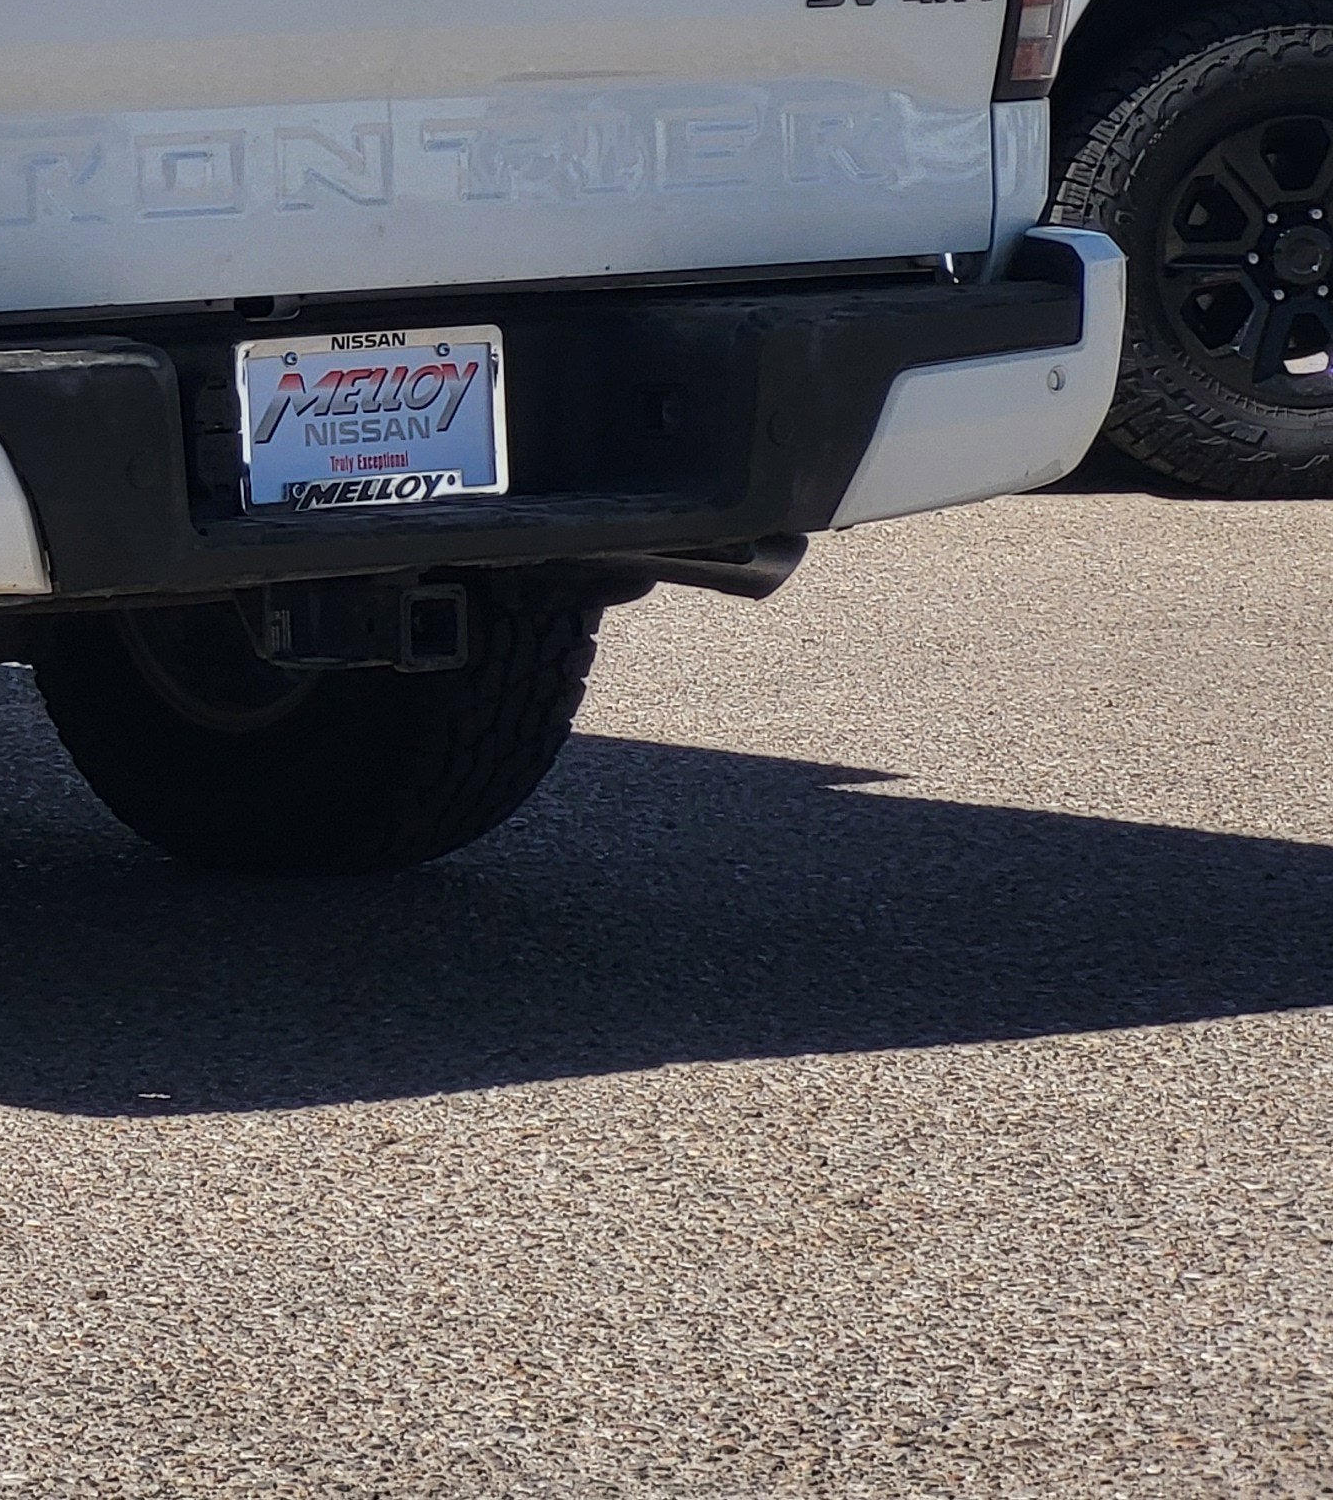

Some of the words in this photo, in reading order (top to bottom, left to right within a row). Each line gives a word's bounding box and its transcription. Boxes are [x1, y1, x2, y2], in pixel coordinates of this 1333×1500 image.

[331, 332, 406, 351] NISSAN
[254, 361, 479, 444] MELLOY
[304, 415, 431, 447] NISSAN
[330, 456, 354, 473] Truly
[357, 451, 409, 471] Exceptional
[298, 473, 444, 510] MELLOY
